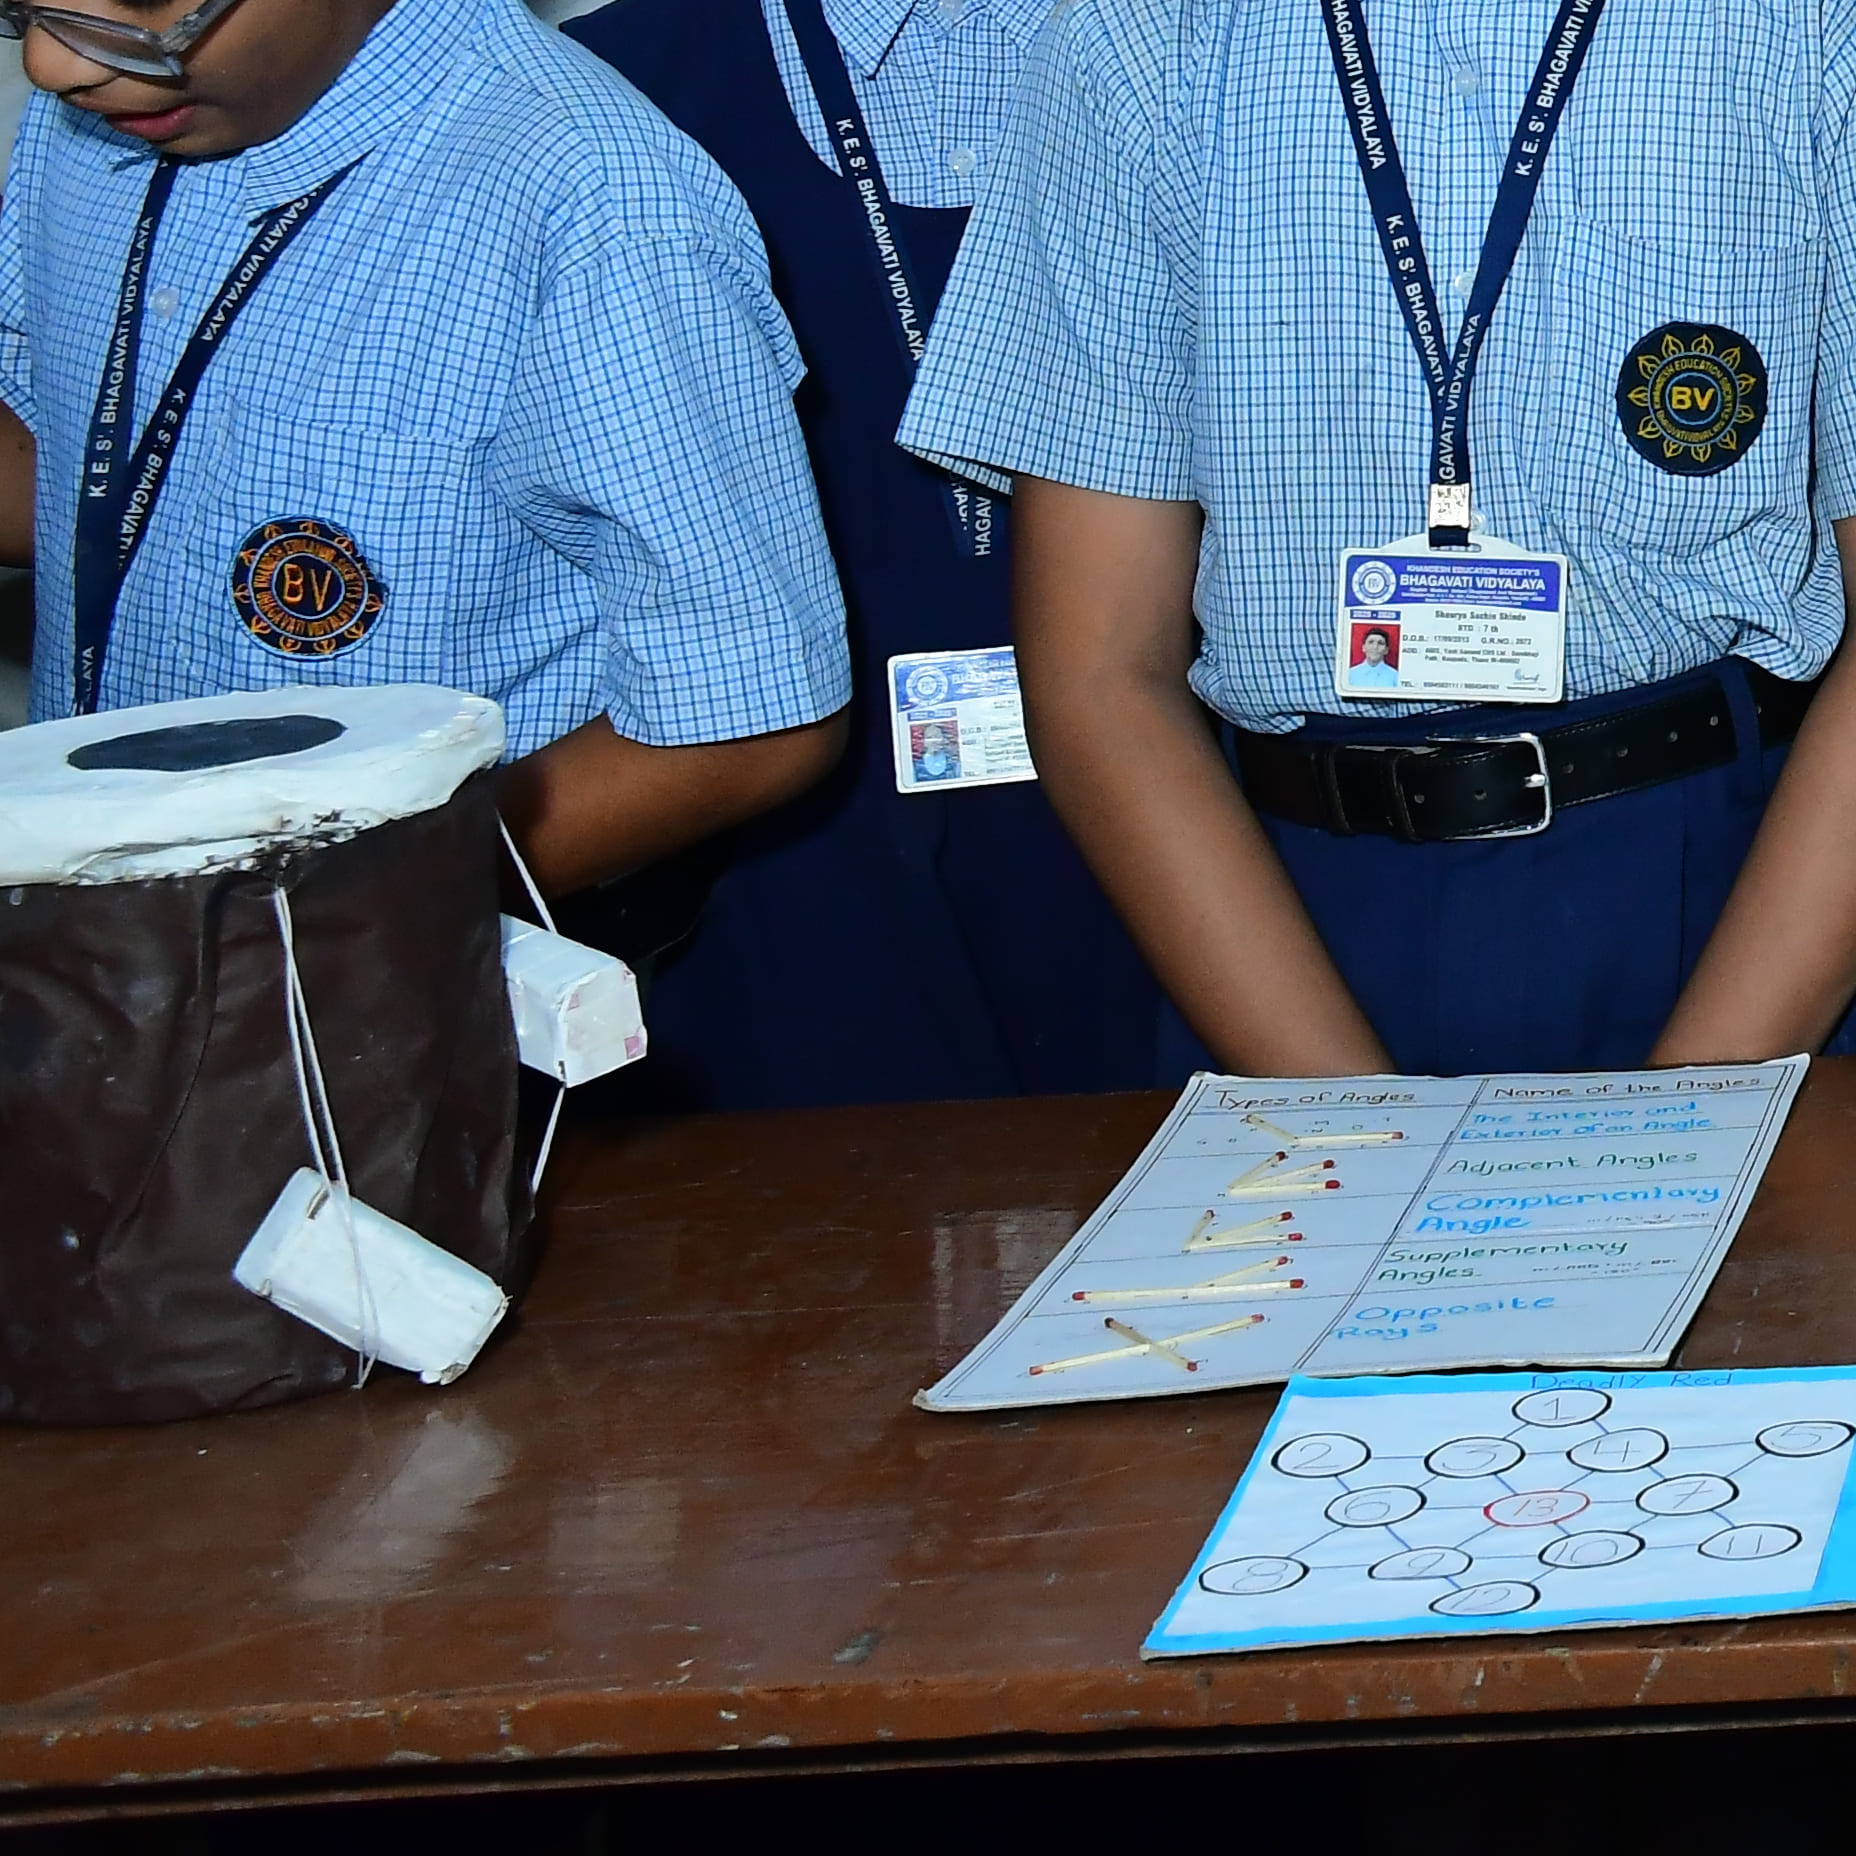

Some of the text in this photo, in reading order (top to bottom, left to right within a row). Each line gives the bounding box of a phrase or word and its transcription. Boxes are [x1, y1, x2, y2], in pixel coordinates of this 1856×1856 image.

[1536, 15, 1585, 109] BHAGAVATI
[1670, 386, 1715, 411] BV
[1400, 574, 1546, 590] BHAGAVATI VIDYALAYA
[1214, 1089, 1416, 1110] Types of Angles
[1494, 1077, 1761, 1099] Name of the Angles
[1447, 1150, 1698, 1176] Adjacent Angles
[1426, 1184, 1721, 1212] Complementary
[1415, 1214, 1532, 1234] Angle
[1388, 1239, 1629, 1265] Supplementary
[1355, 1294, 1556, 1323] Opposite
[1669, 1371, 1733, 1388] Red
[1509, 1495, 1561, 1518] 13
[1556, 1533, 1619, 1565] 10
